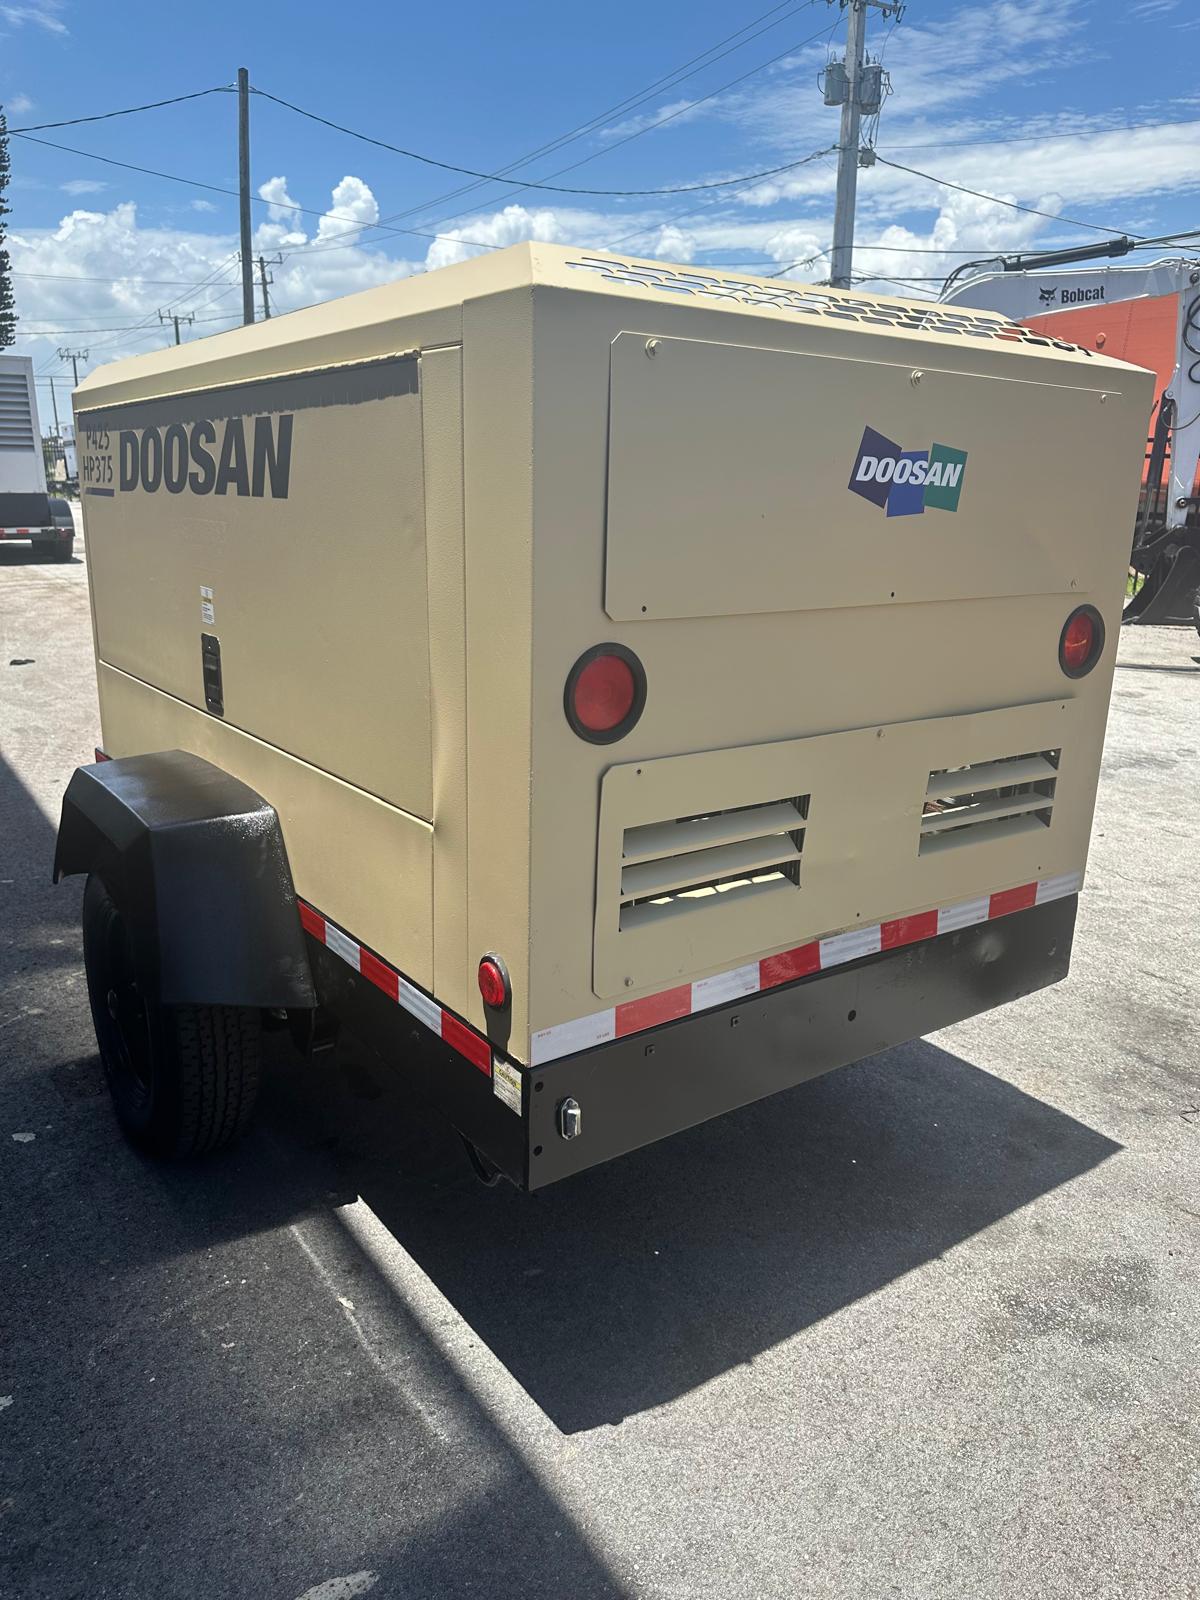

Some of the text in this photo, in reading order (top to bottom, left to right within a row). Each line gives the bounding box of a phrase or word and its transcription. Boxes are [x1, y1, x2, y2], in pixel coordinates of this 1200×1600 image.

[1061, 285, 1105, 304] Bobcat
[83, 455, 113, 483] HP375
[119, 413, 294, 499] DOOSAN
[855, 456, 963, 488] DOOSAN
